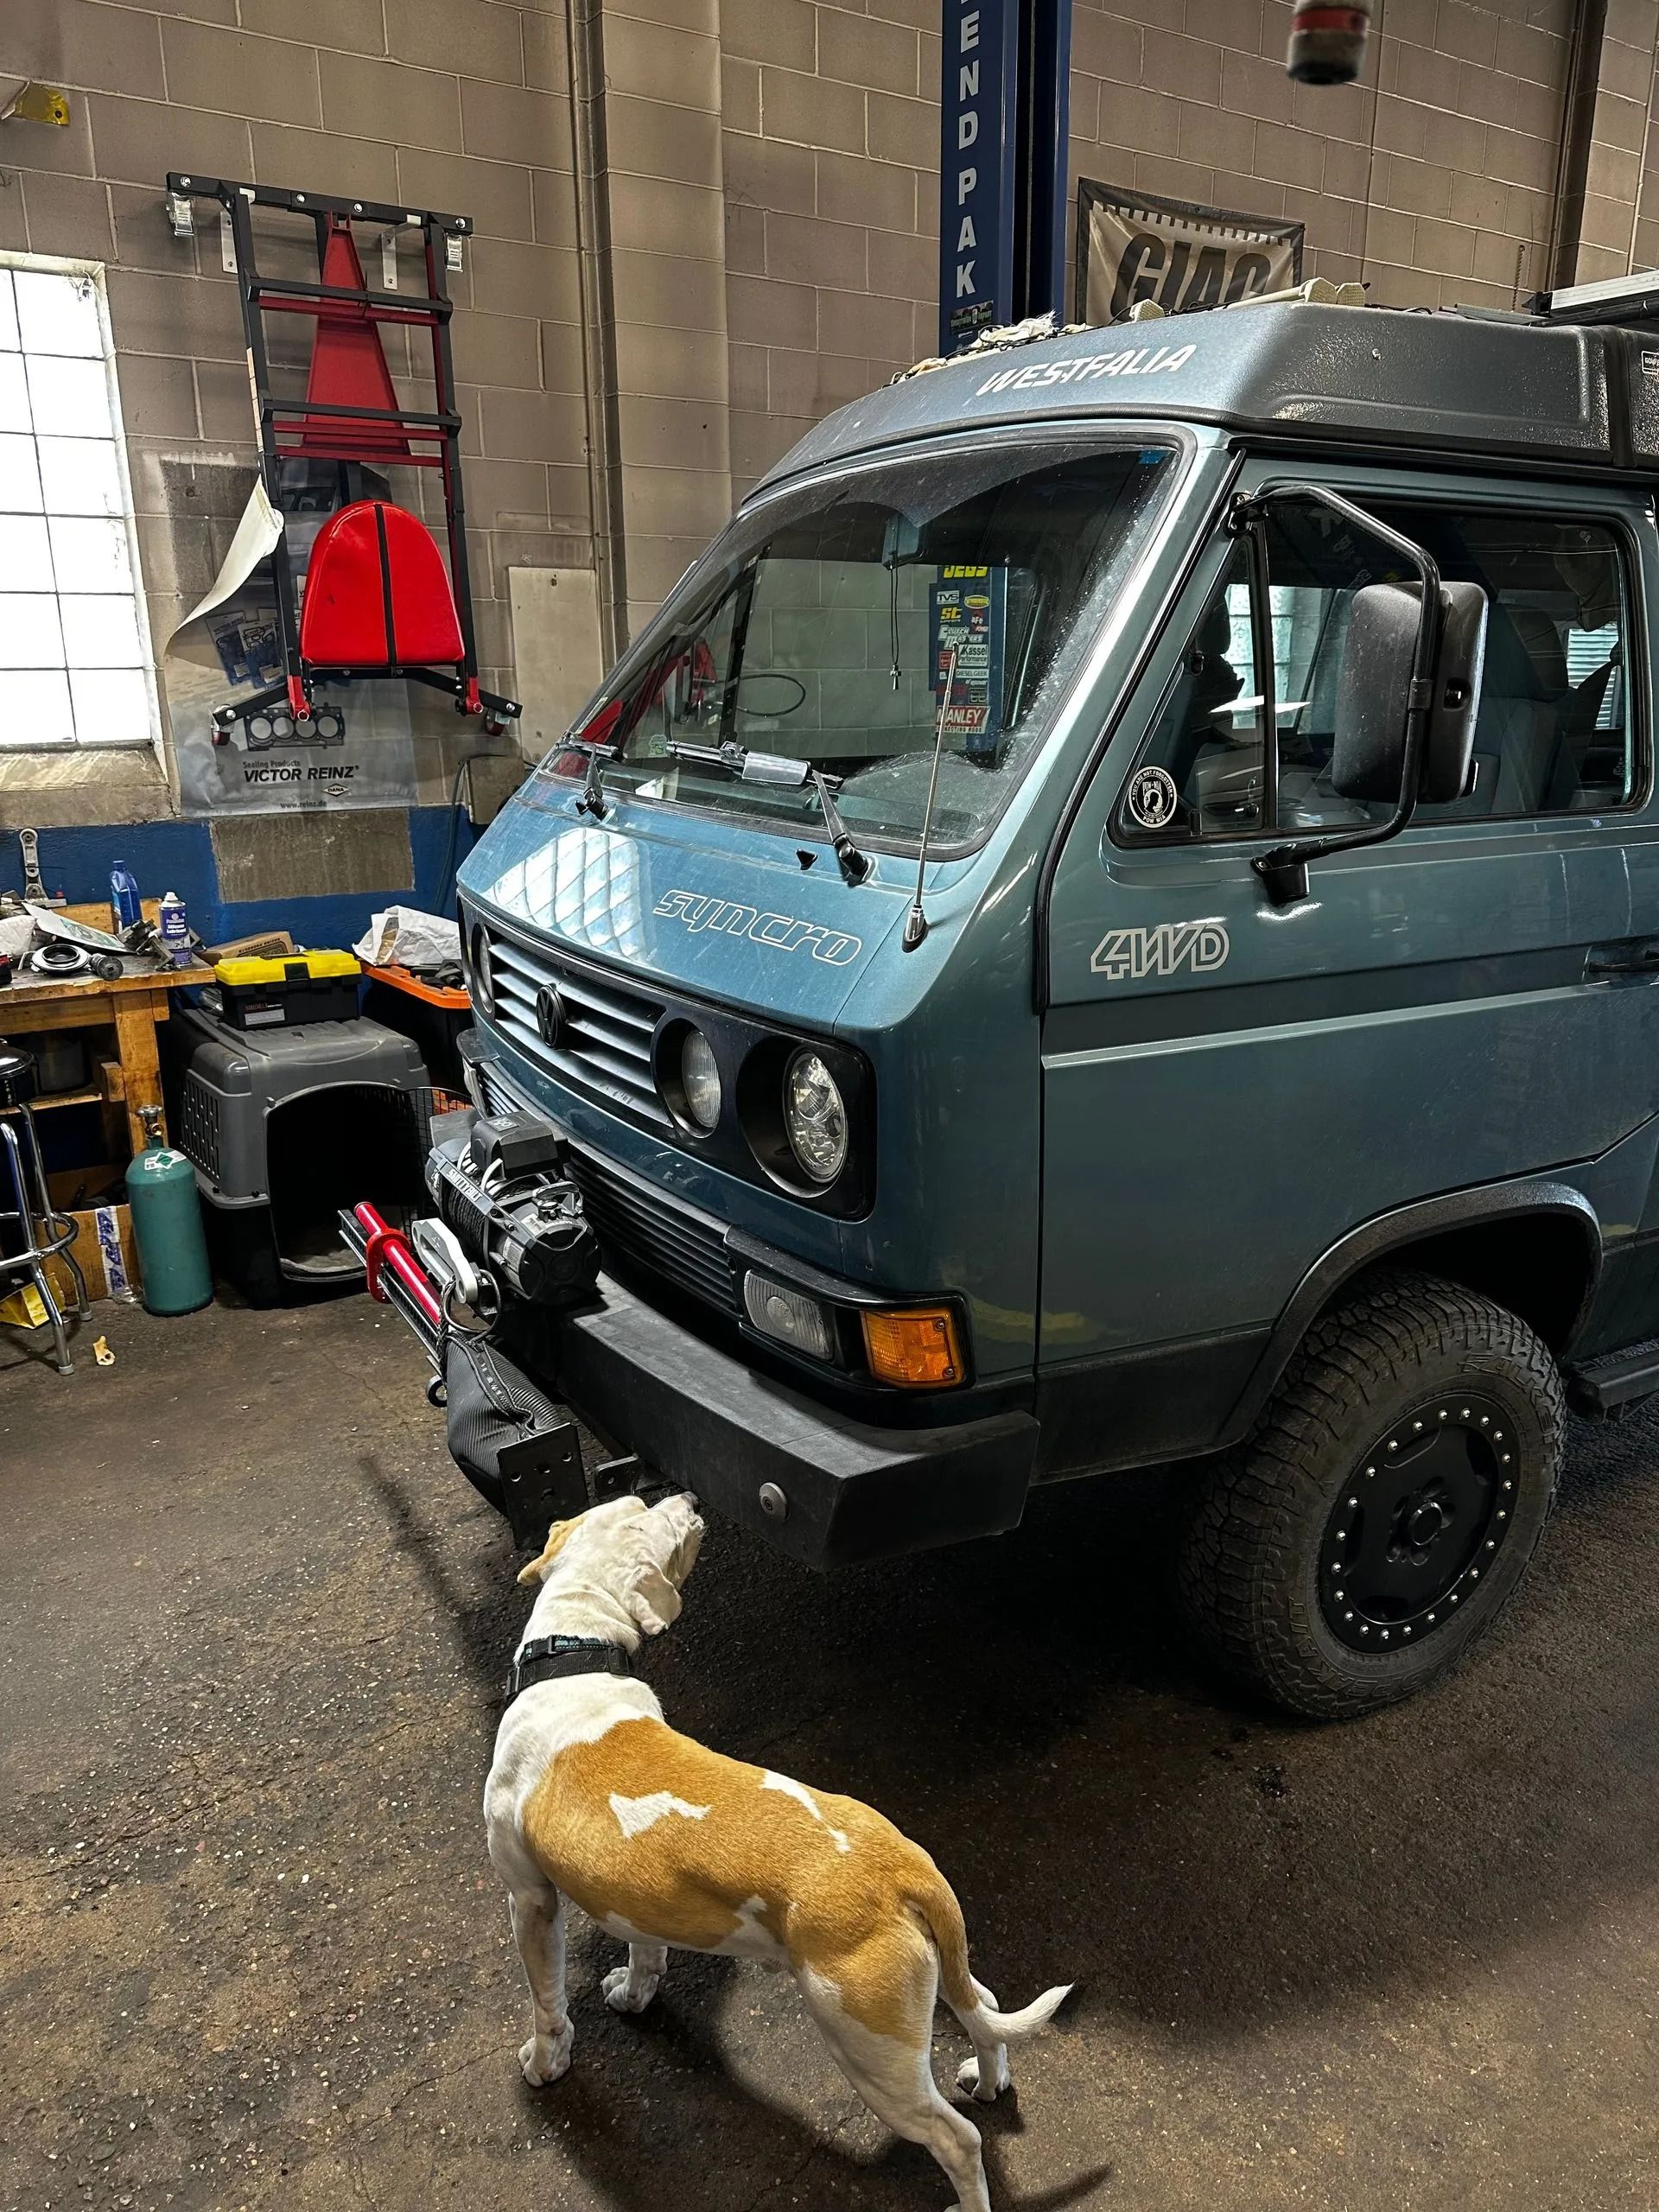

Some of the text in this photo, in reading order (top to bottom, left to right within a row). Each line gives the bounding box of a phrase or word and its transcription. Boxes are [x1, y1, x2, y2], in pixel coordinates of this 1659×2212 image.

[956, 0, 981, 299] ENDPAK
[976, 344, 1198, 397] WESTFALIA
[960, 645, 988, 657] Kassel
[936, 709, 982, 724] MANLEY
[243, 760, 269, 769] Sealing
[244, 768, 302, 783] VICTOR
[280, 800, 327, 809] www.reinz.de
[1142, 814, 1166, 823] POW MIA
[652, 889, 862, 966] syncro
[1090, 923, 1230, 981] 4WD
